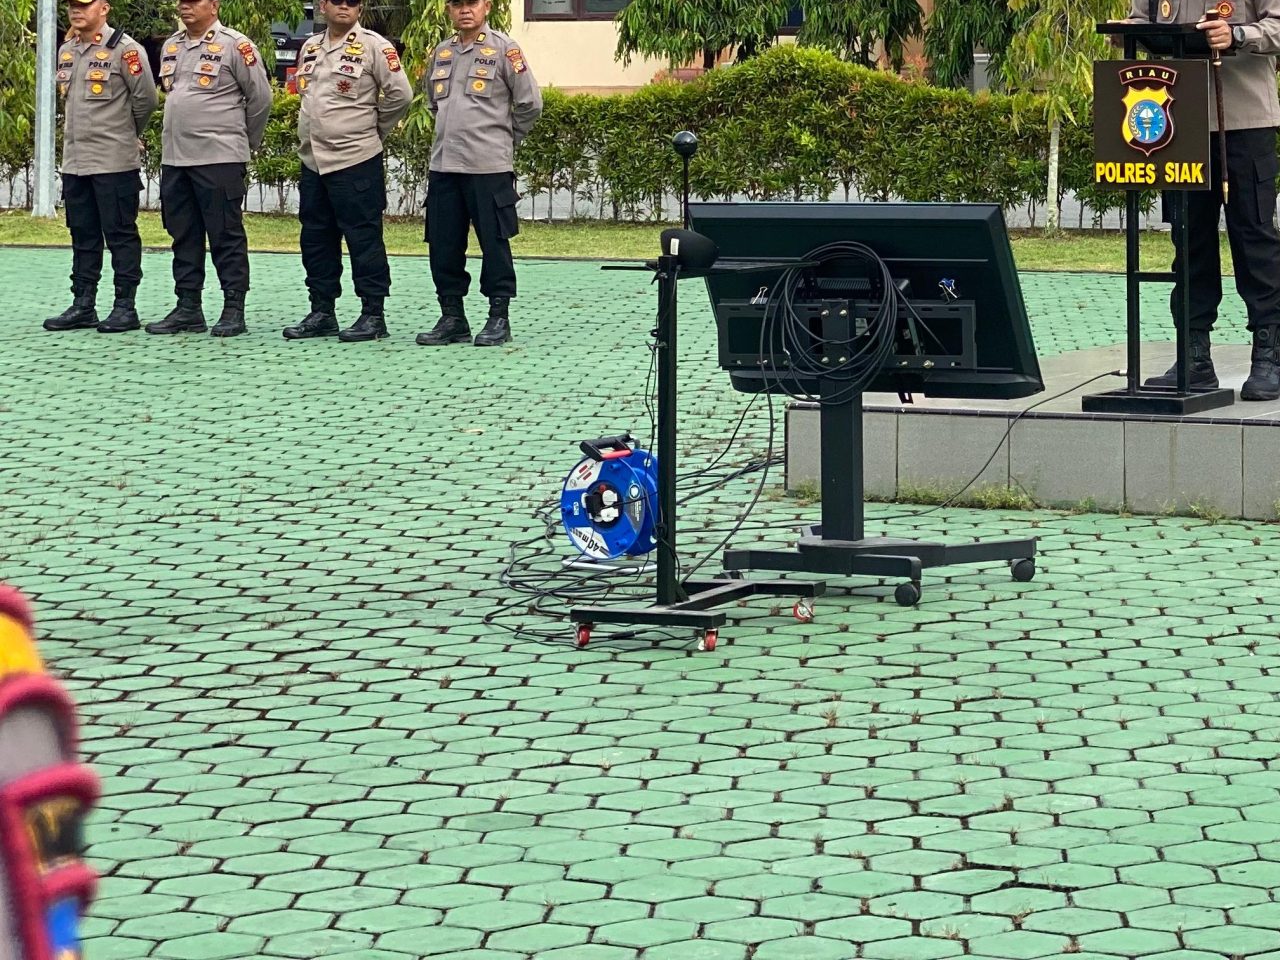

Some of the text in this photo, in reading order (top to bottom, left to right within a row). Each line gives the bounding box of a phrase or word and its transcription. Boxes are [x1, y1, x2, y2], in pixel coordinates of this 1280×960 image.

[200, 53, 222, 62] POLRI
[340, 55, 363, 64] POLRI
[474, 57, 496, 66] POLRI
[1125, 69, 1170, 80] RIAU
[1095, 162, 1204, 184] POLRES SIAK
